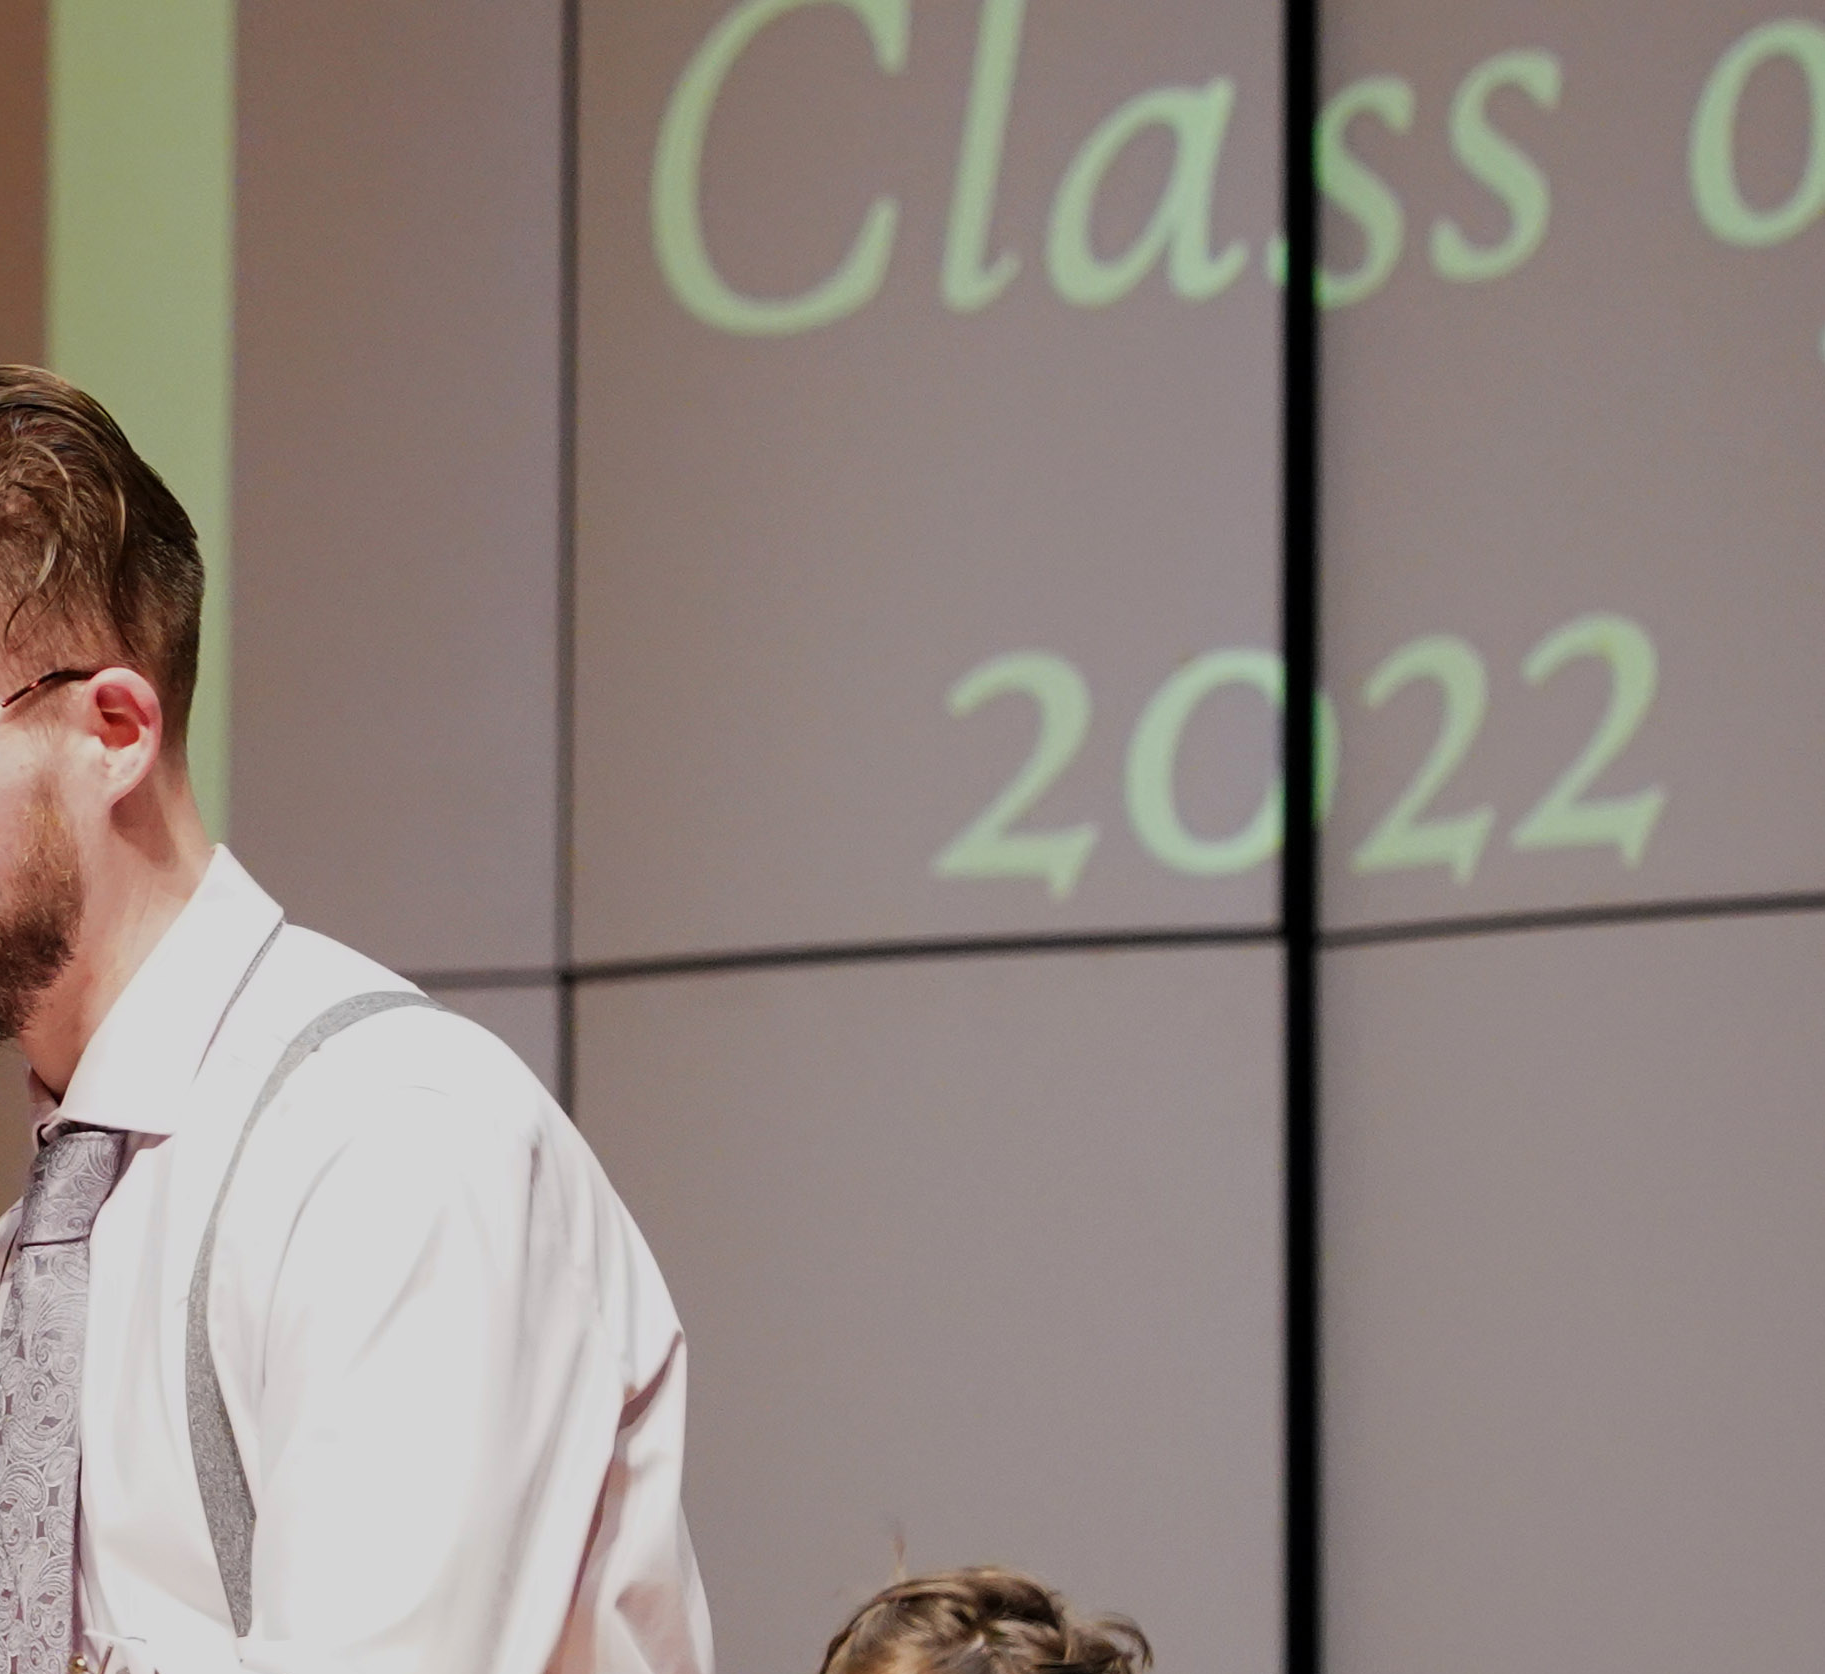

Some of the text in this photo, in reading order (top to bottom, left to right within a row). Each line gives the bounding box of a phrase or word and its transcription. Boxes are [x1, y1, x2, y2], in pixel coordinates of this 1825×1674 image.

[649, 0, 1825, 335] Class o
[930, 612, 1667, 900] 2022
